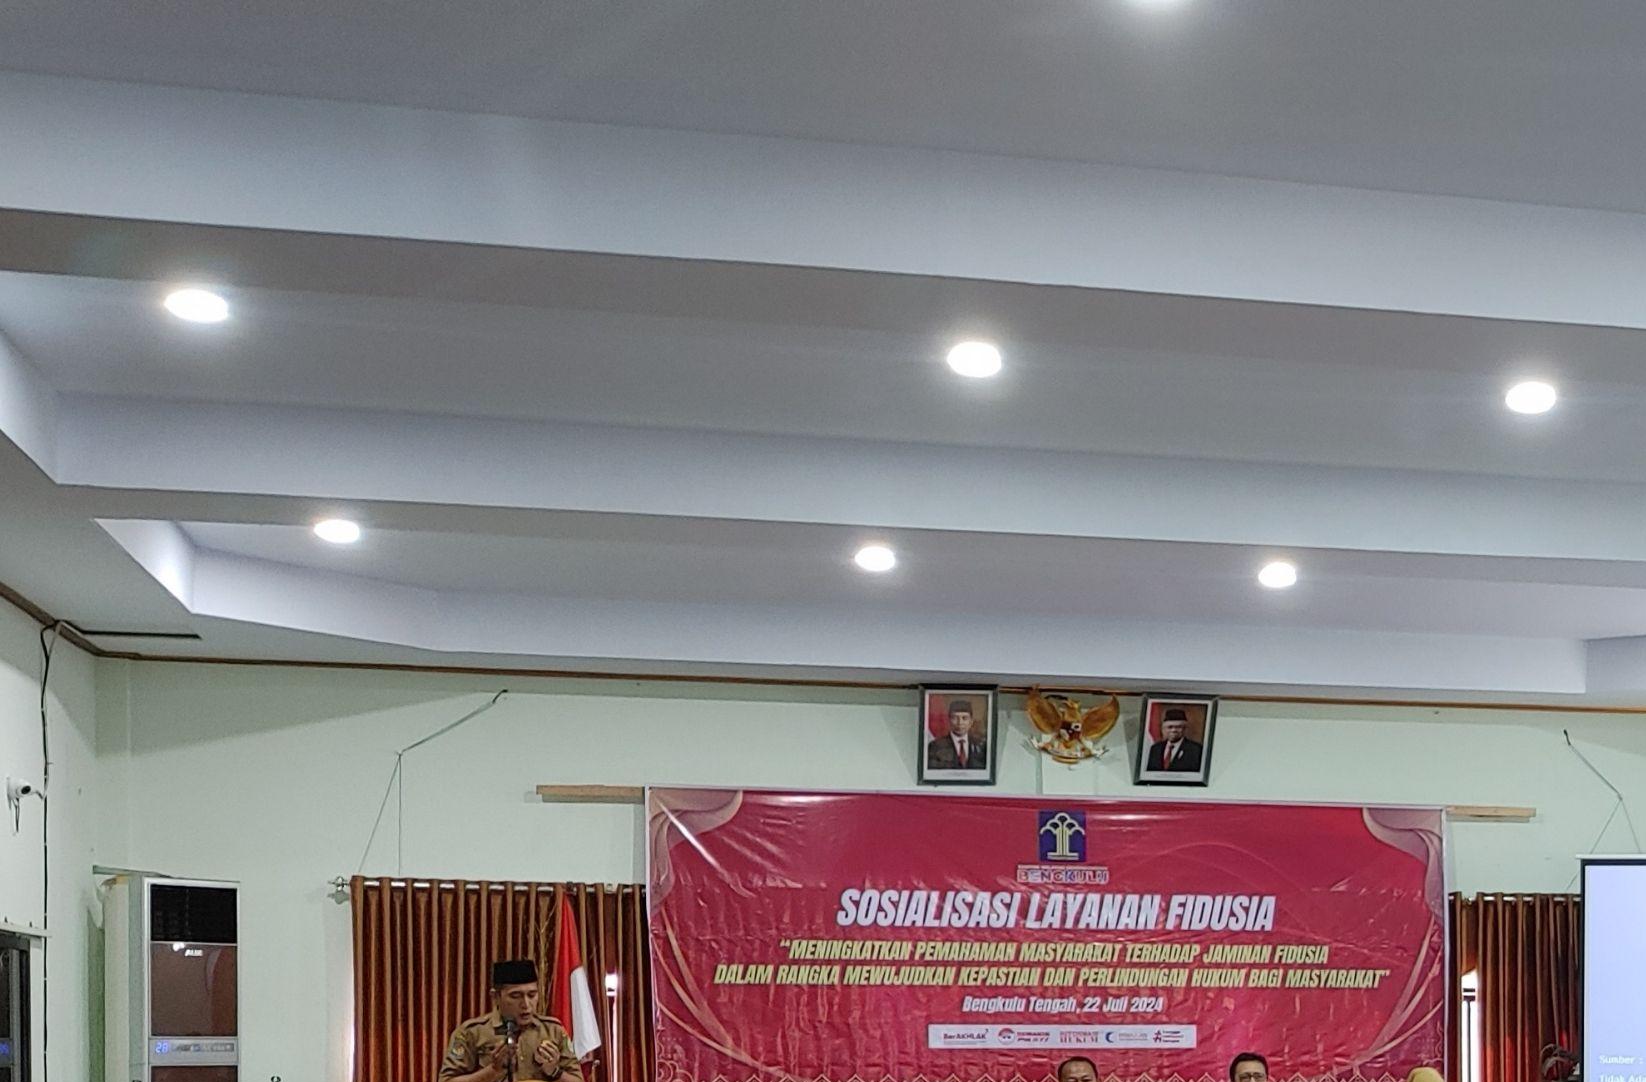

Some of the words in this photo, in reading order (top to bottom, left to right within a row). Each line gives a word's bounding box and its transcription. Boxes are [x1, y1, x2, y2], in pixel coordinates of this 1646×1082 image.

[1017, 868, 1109, 884] BENGKULU
[836, 888, 1021, 928] SOSIALISASI
[1025, 892, 1161, 930] LAYANAN
[1165, 894, 1277, 931] FIDUSIA
[914, 941, 1018, 962] PEMAHAMAN
[1019, 942, 1122, 962] MASYARAKAT
[1125, 943, 1200, 963] TERHADAP
[1202, 944, 1272, 964] JAMINAN
[1274, 945, 1330, 964] FIDUSIA
[714, 964, 773, 985] DALAM
[776, 965, 841, 985] RANGKA
[843, 966, 956, 986] MEWUJUDKAN
[958, 966, 1041, 987] KEPASTIAN
[1043, 967, 1075, 987] DAN
[1078, 968, 1189, 988] PERLINDUNGAN
[1191, 968, 1247, 988] HUKUM
[1248, 969, 1283, 988] BAGI
[962, 995, 1026, 1013] Bengkulu
[1028, 996, 1081, 1014] Tengah,
[1082, 997, 1100, 1012] 22
[1102, 996, 1128, 1012] Juli
[1130, 997, 1164, 1013] 2024
[1599, 1054, 1635, 1065] Sumber
